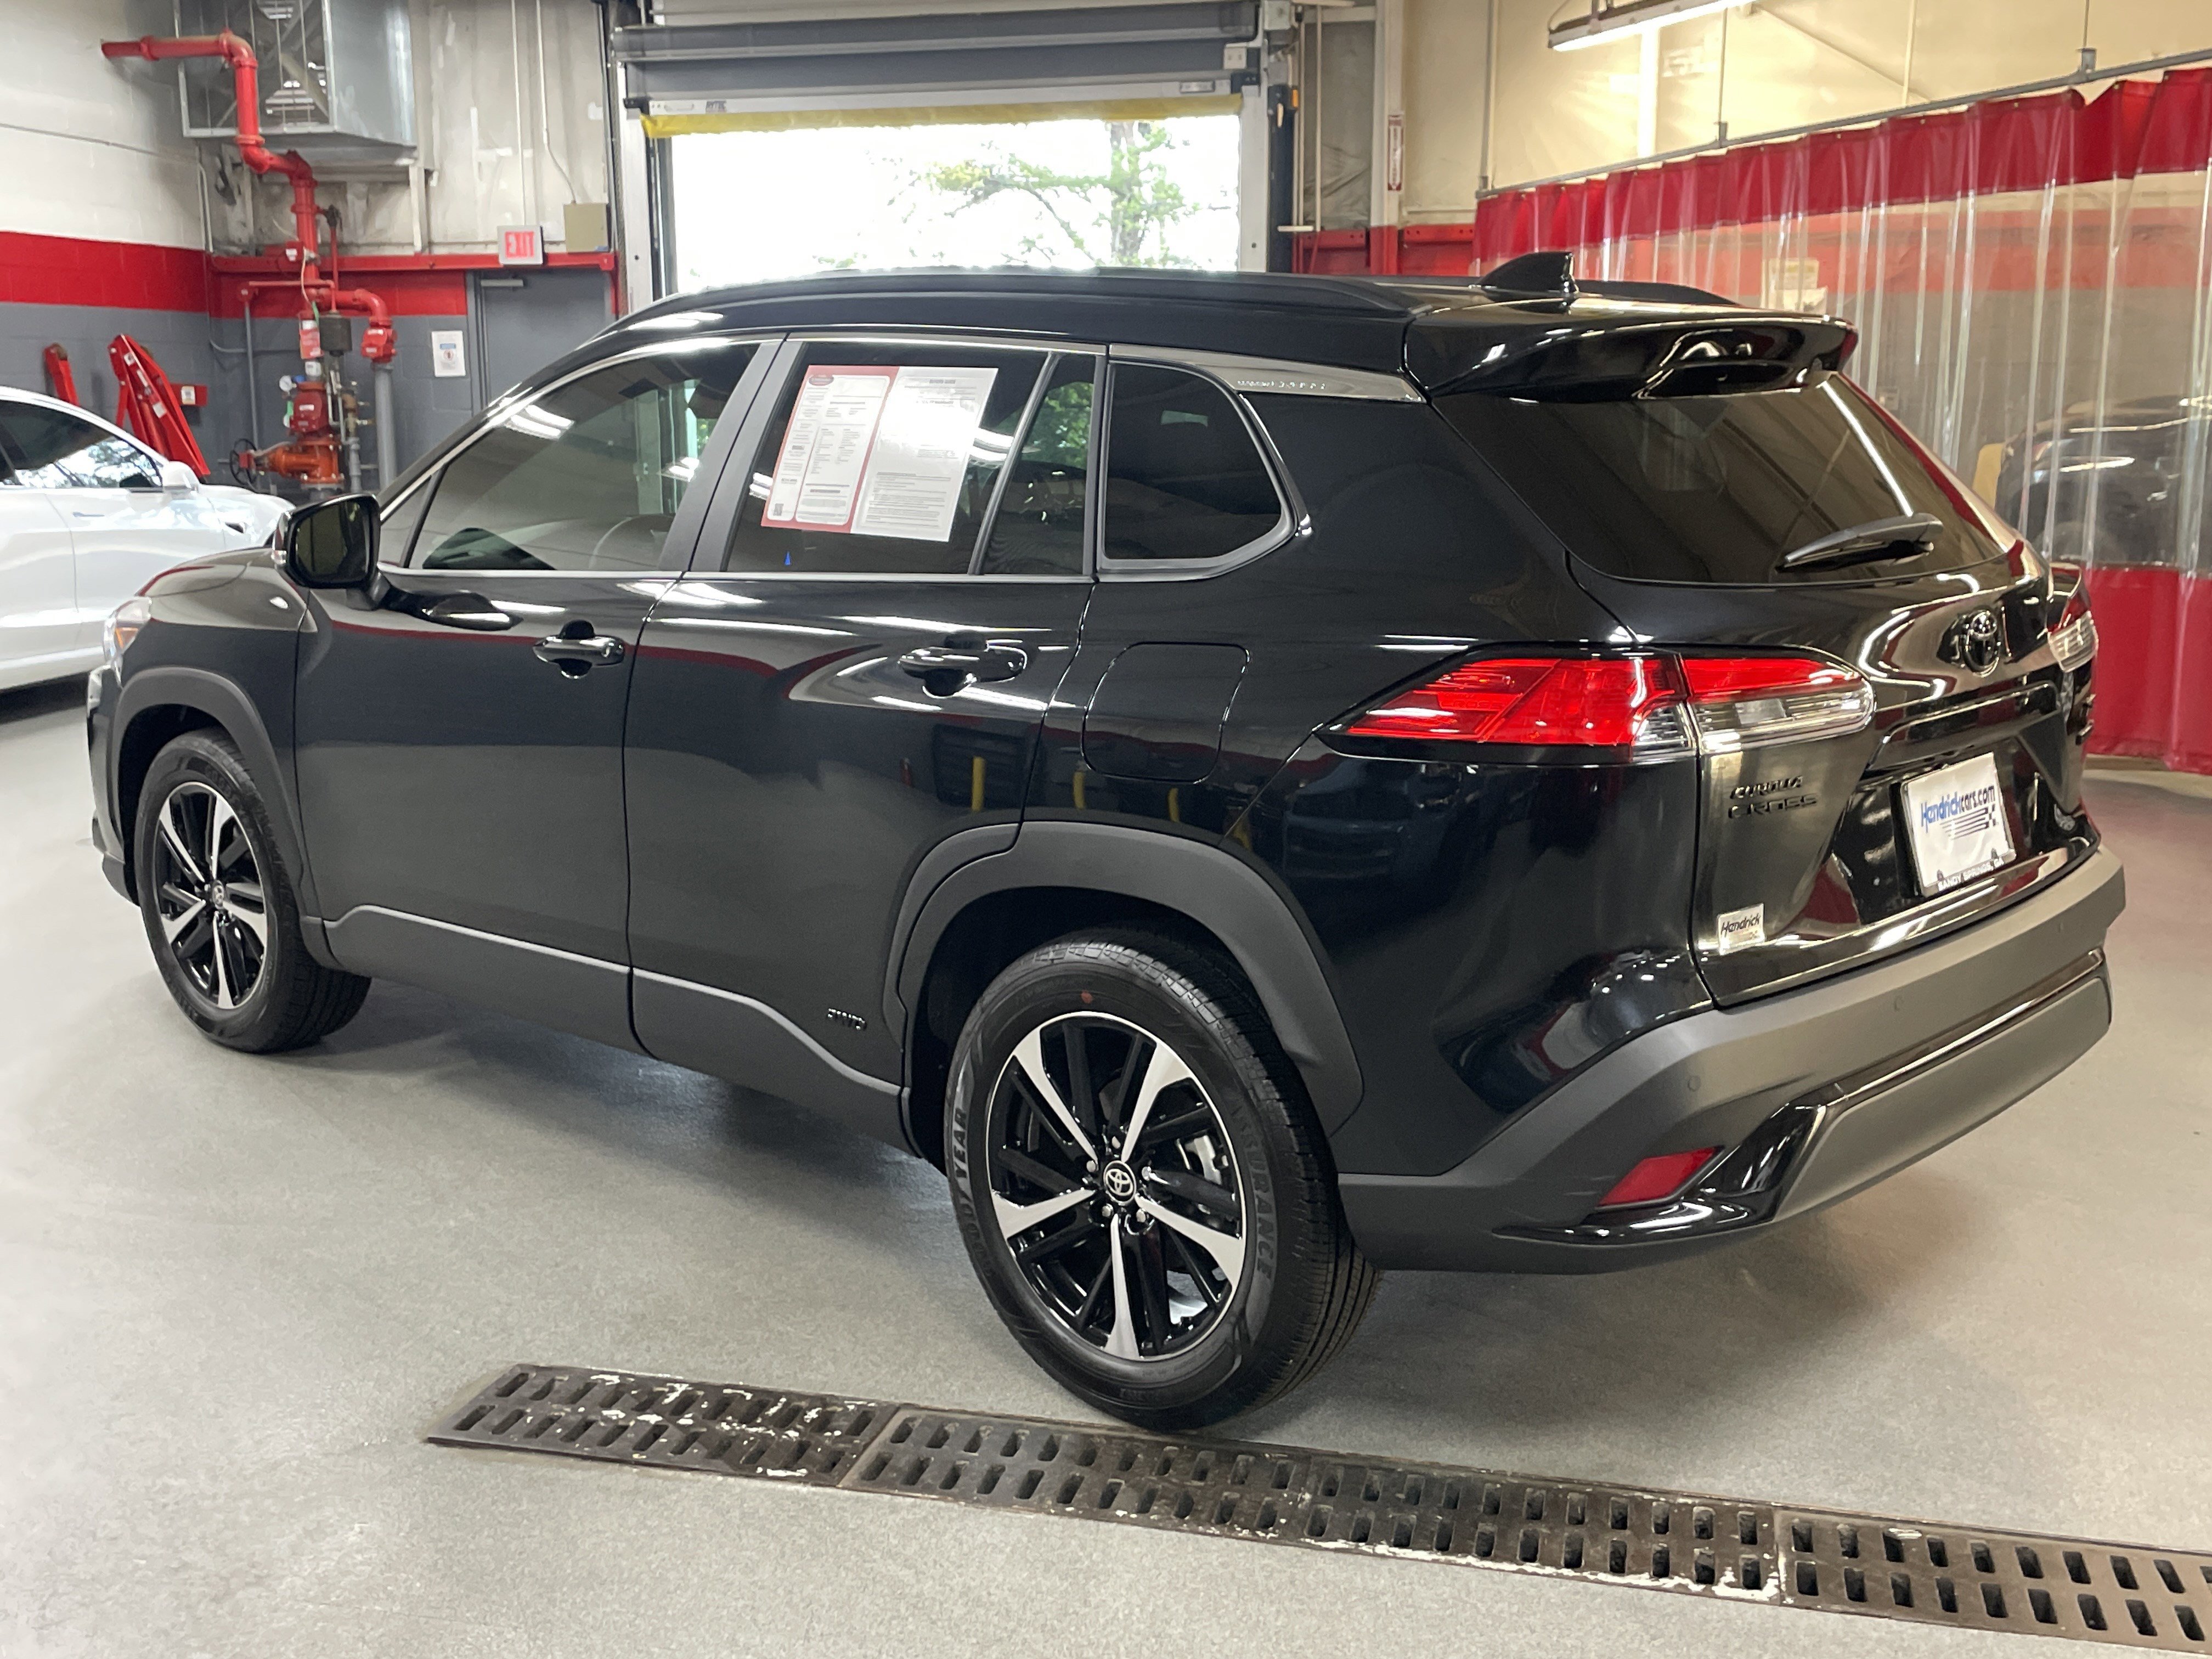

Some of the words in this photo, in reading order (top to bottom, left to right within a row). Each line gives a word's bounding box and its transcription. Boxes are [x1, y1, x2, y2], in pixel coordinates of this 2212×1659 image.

[505, 231, 534, 259] EXIT
[1728, 793, 1817, 819] CROSS
[1721, 913, 1761, 938] Hendrick
[953, 1107, 967, 1179] YEAR
